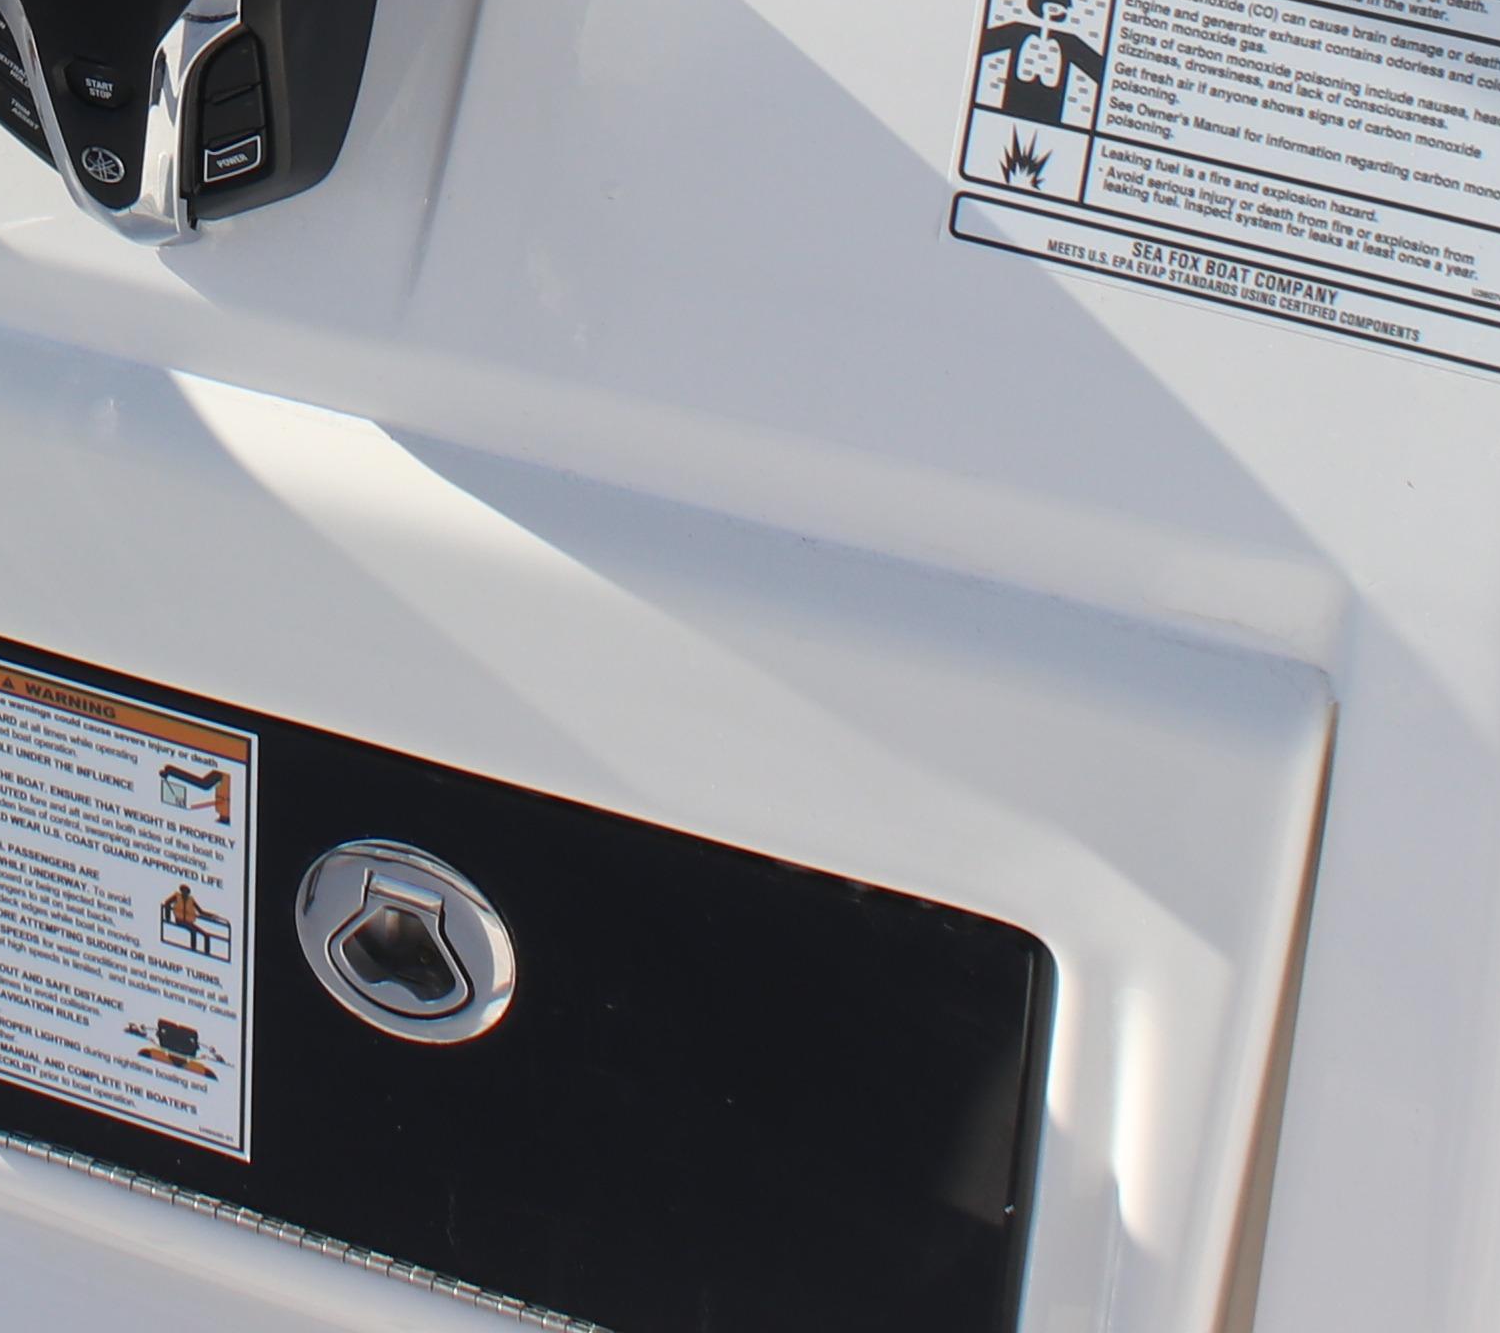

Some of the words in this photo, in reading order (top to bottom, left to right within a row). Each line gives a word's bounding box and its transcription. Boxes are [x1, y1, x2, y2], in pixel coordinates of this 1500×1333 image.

[1120, 11, 1170, 32] carbon
[1169, 23, 1238, 47] monoxide
[1237, 38, 1268, 55] gas.
[1246, 1, 1280, 24] (CO)
[1279, 12, 1307, 27] can
[1307, 18, 1351, 37] cause
[1350, 25, 1388, 45] brain
[1388, 33, 1445, 59] damage
[1445, 50, 1463, 62] or
[1406, 4, 1450, 22] water.
[1171, 8, 1201, 23] and
[1199, 14, 1268, 38] generator
[1267, 29, 1324, 51] exhaust
[1323, 42, 1384, 65] contains
[1383, 54, 1447, 79] odorless
[1446, 70, 1477, 86] and
[85, 77, 113, 91] START
[88, 88, 113, 100] STOP
[216, 150, 249, 169] POWER
[1099, 144, 1152, 172] Leaking
[1154, 157, 1181, 175] fuel
[1182, 164, 1195, 179] is
[1197, 171, 1206, 182] a
[1208, 170, 1231, 187] fire
[1233, 179, 1260, 194] and
[1261, 186, 1327, 210] explosion
[1328, 198, 1379, 223] hazard.
[1045, 238, 1087, 261] MEETS
[1085, 248, 1109, 267] U.S.
[1110, 254, 1136, 273] EPA
[1134, 260, 1168, 281] EVAP
[1166, 268, 1240, 298] STANDARDS
[1238, 285, 1278, 308] USING
[1277, 295, 1339, 323] CERTIFIED
[1337, 309, 1422, 343] COMPONENTS
[1130, 240, 1166, 264] SEA
[1166, 249, 1202, 273] FOX
[1203, 258, 1252, 286] BOAT
[1252, 270, 1339, 307] COMPANY
[25, 681, 115, 719] WARNING
[18, 719, 29, 730] at
[29, 722, 42, 734] all
[42, 724, 68, 742] times
[68, 734, 94, 749] while
[94, 742, 139, 765] operating
[49, 783, 92, 807] ENSURE
[93, 796, 121, 815] THAT
[122, 805, 165, 829] WEIGHT
[165, 818, 177, 832] IS
[178, 822, 236, 850] PROPERLY
